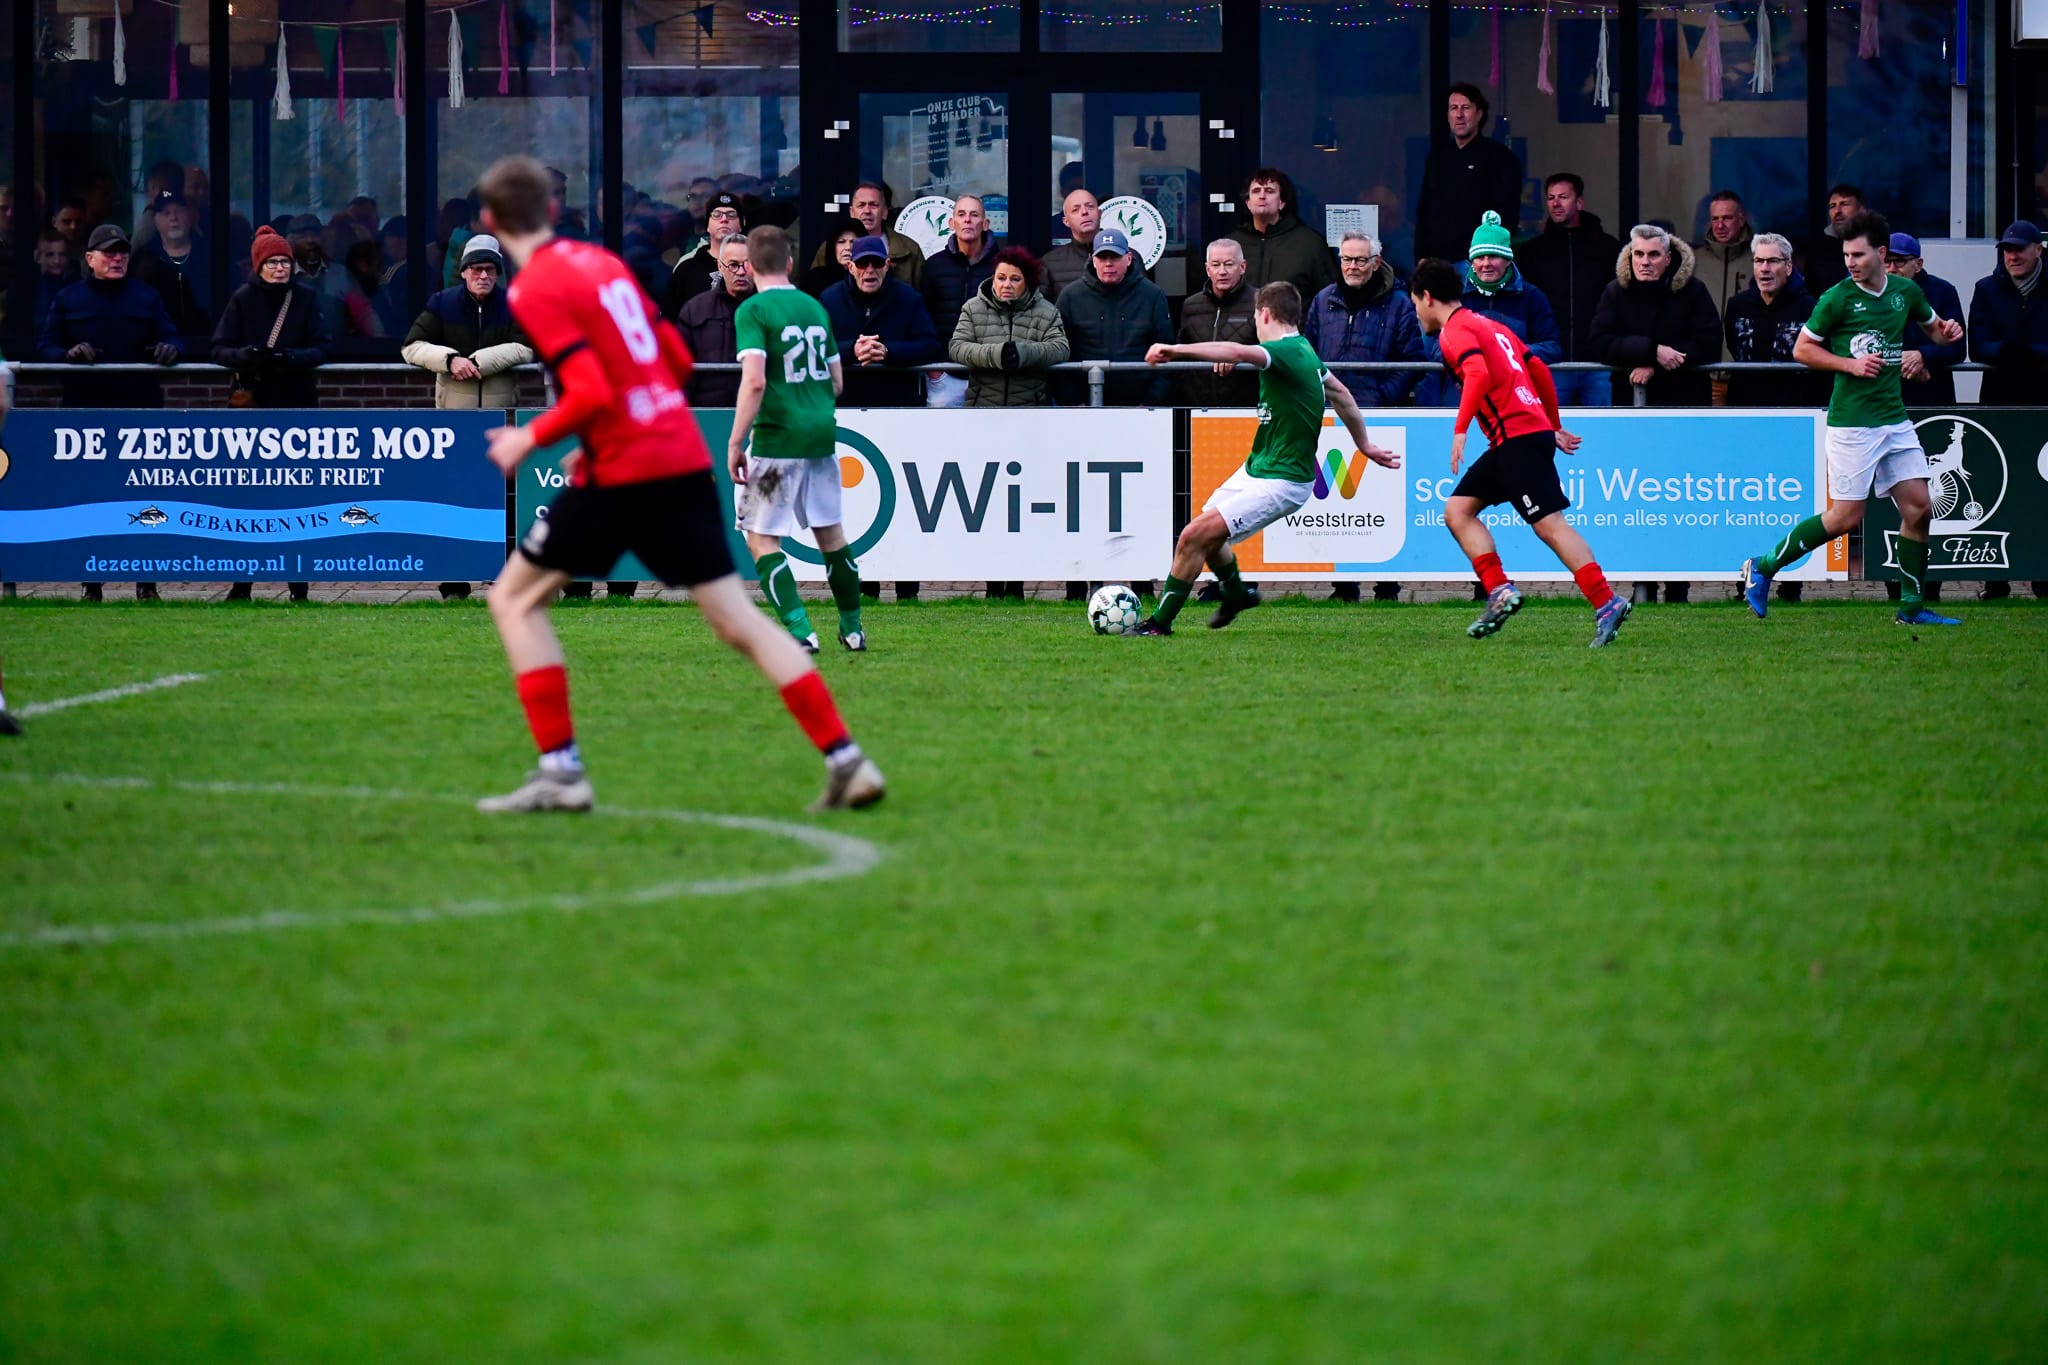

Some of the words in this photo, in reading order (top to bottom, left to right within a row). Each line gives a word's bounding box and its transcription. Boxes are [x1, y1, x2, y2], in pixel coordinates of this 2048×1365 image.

[927, 99, 953, 113] ONZE
[956, 95, 981, 109] CLUB
[927, 114, 938, 125] IS
[941, 107, 981, 123] HELDER
[780, 324, 832, 383] 20
[53, 427, 108, 461] DE
[117, 427, 362, 461] ZEEUWSCHE
[371, 427, 456, 461] MOP
[124, 467, 315, 488] AMBACHTELIJKE
[319, 467, 385, 487] FRIET
[1596, 467, 1803, 502] Weststrate
[901, 460, 1144, 533] Wi-IT
[179, 509, 293, 534] GEBAKKEN
[296, 511, 330, 531] VIS
[1285, 512, 1386, 528] weststrate
[1593, 513, 1618, 526] en
[1623, 509, 1668, 526] alles
[1673, 513, 1720, 526] voor
[1725, 509, 1801, 526] kantoor
[1942, 537, 1998, 563] Fiets
[85, 554, 287, 576] dezeeuwschemop.nl
[312, 554, 425, 573] zoutelande
